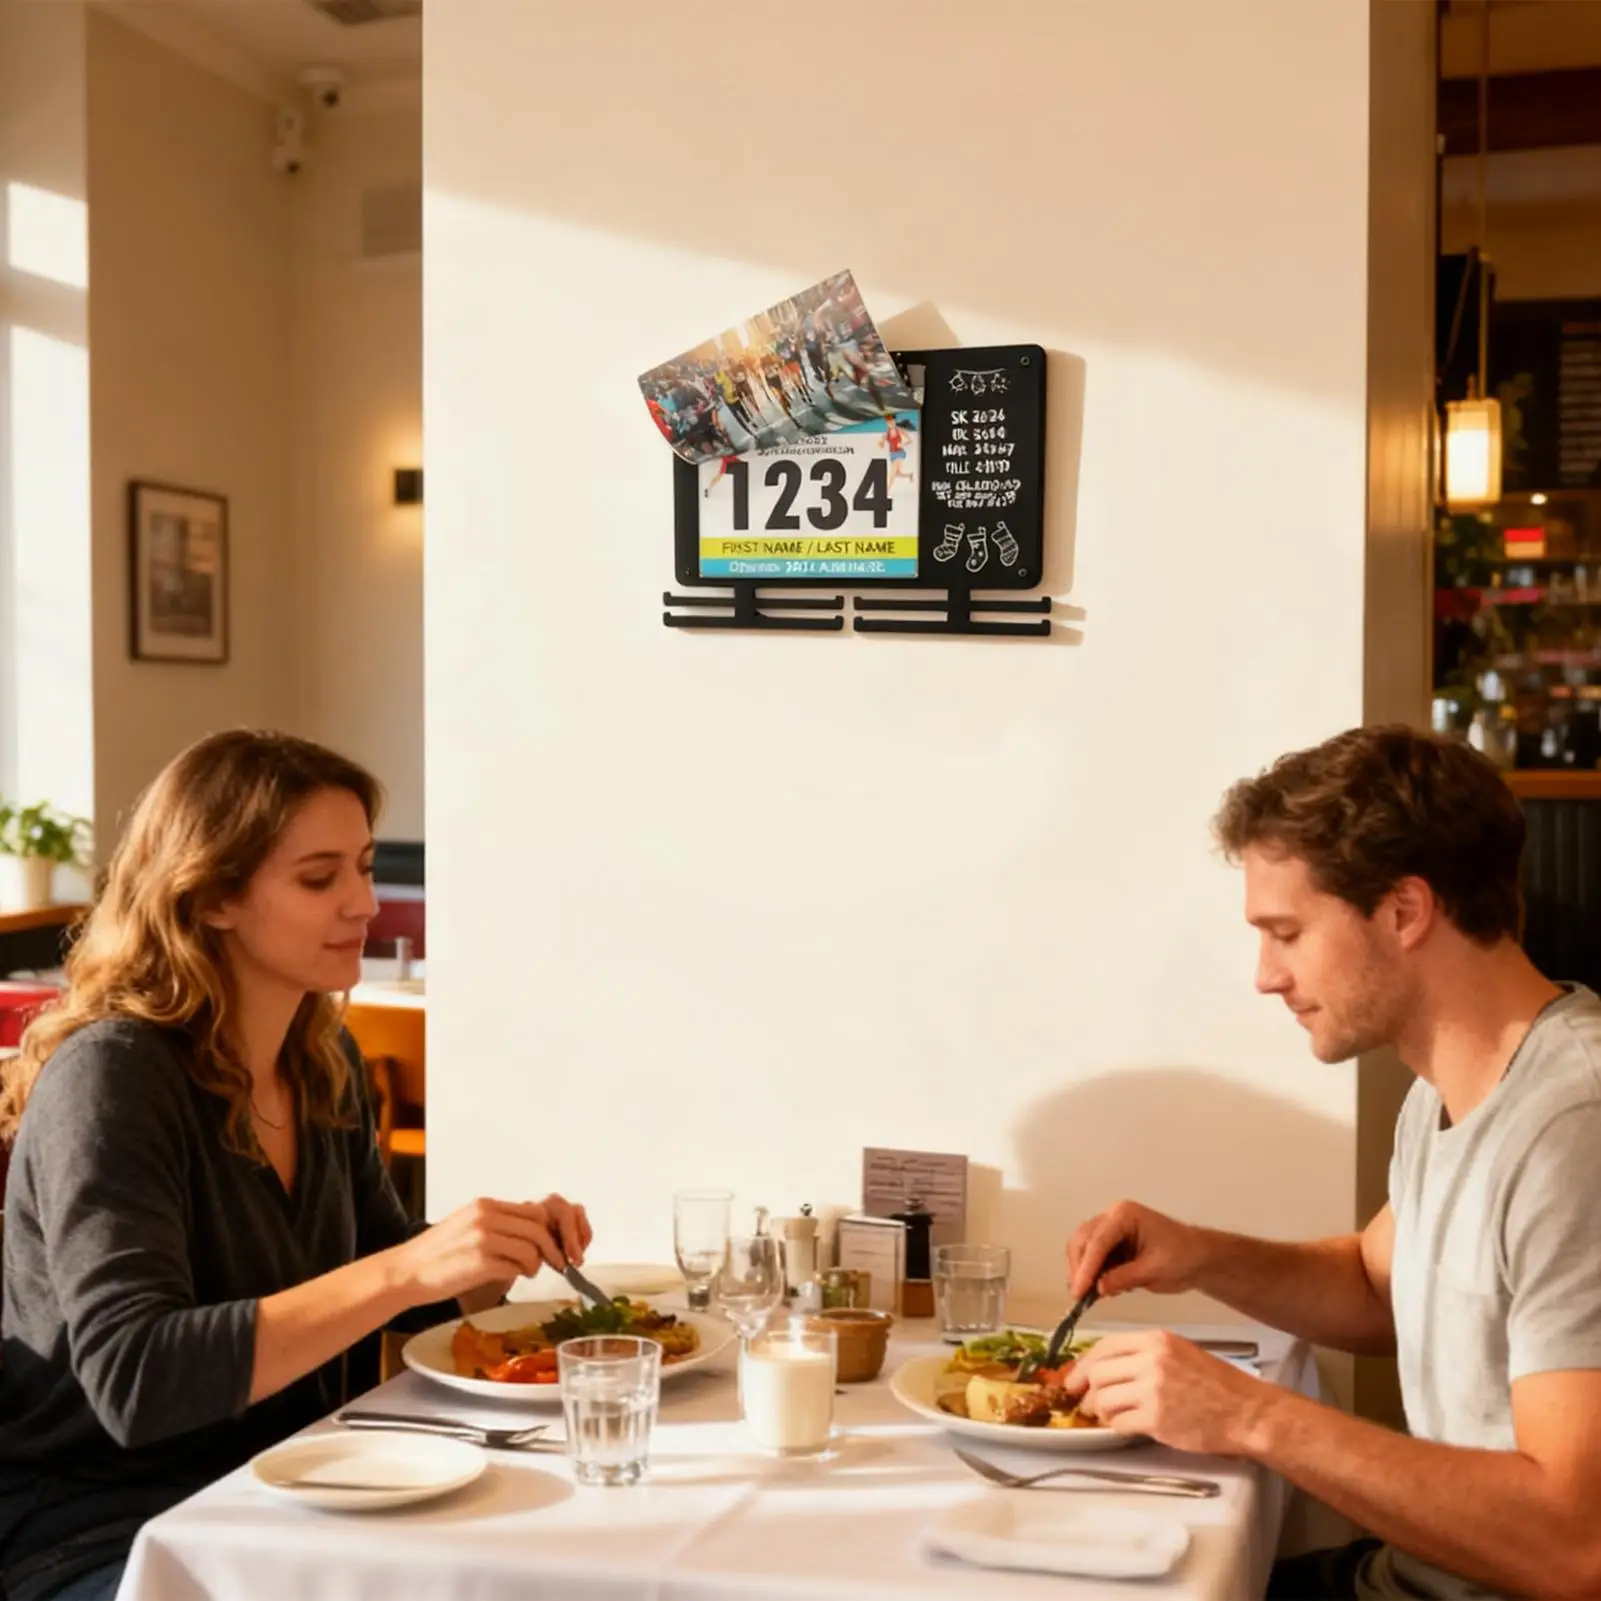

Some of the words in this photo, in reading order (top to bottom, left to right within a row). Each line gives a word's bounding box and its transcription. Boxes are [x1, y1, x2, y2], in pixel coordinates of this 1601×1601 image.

[726, 458, 893, 531] 1234
[763, 541, 803, 554] NAME
[817, 541, 852, 554] LAST
[854, 541, 896, 555] NAME
